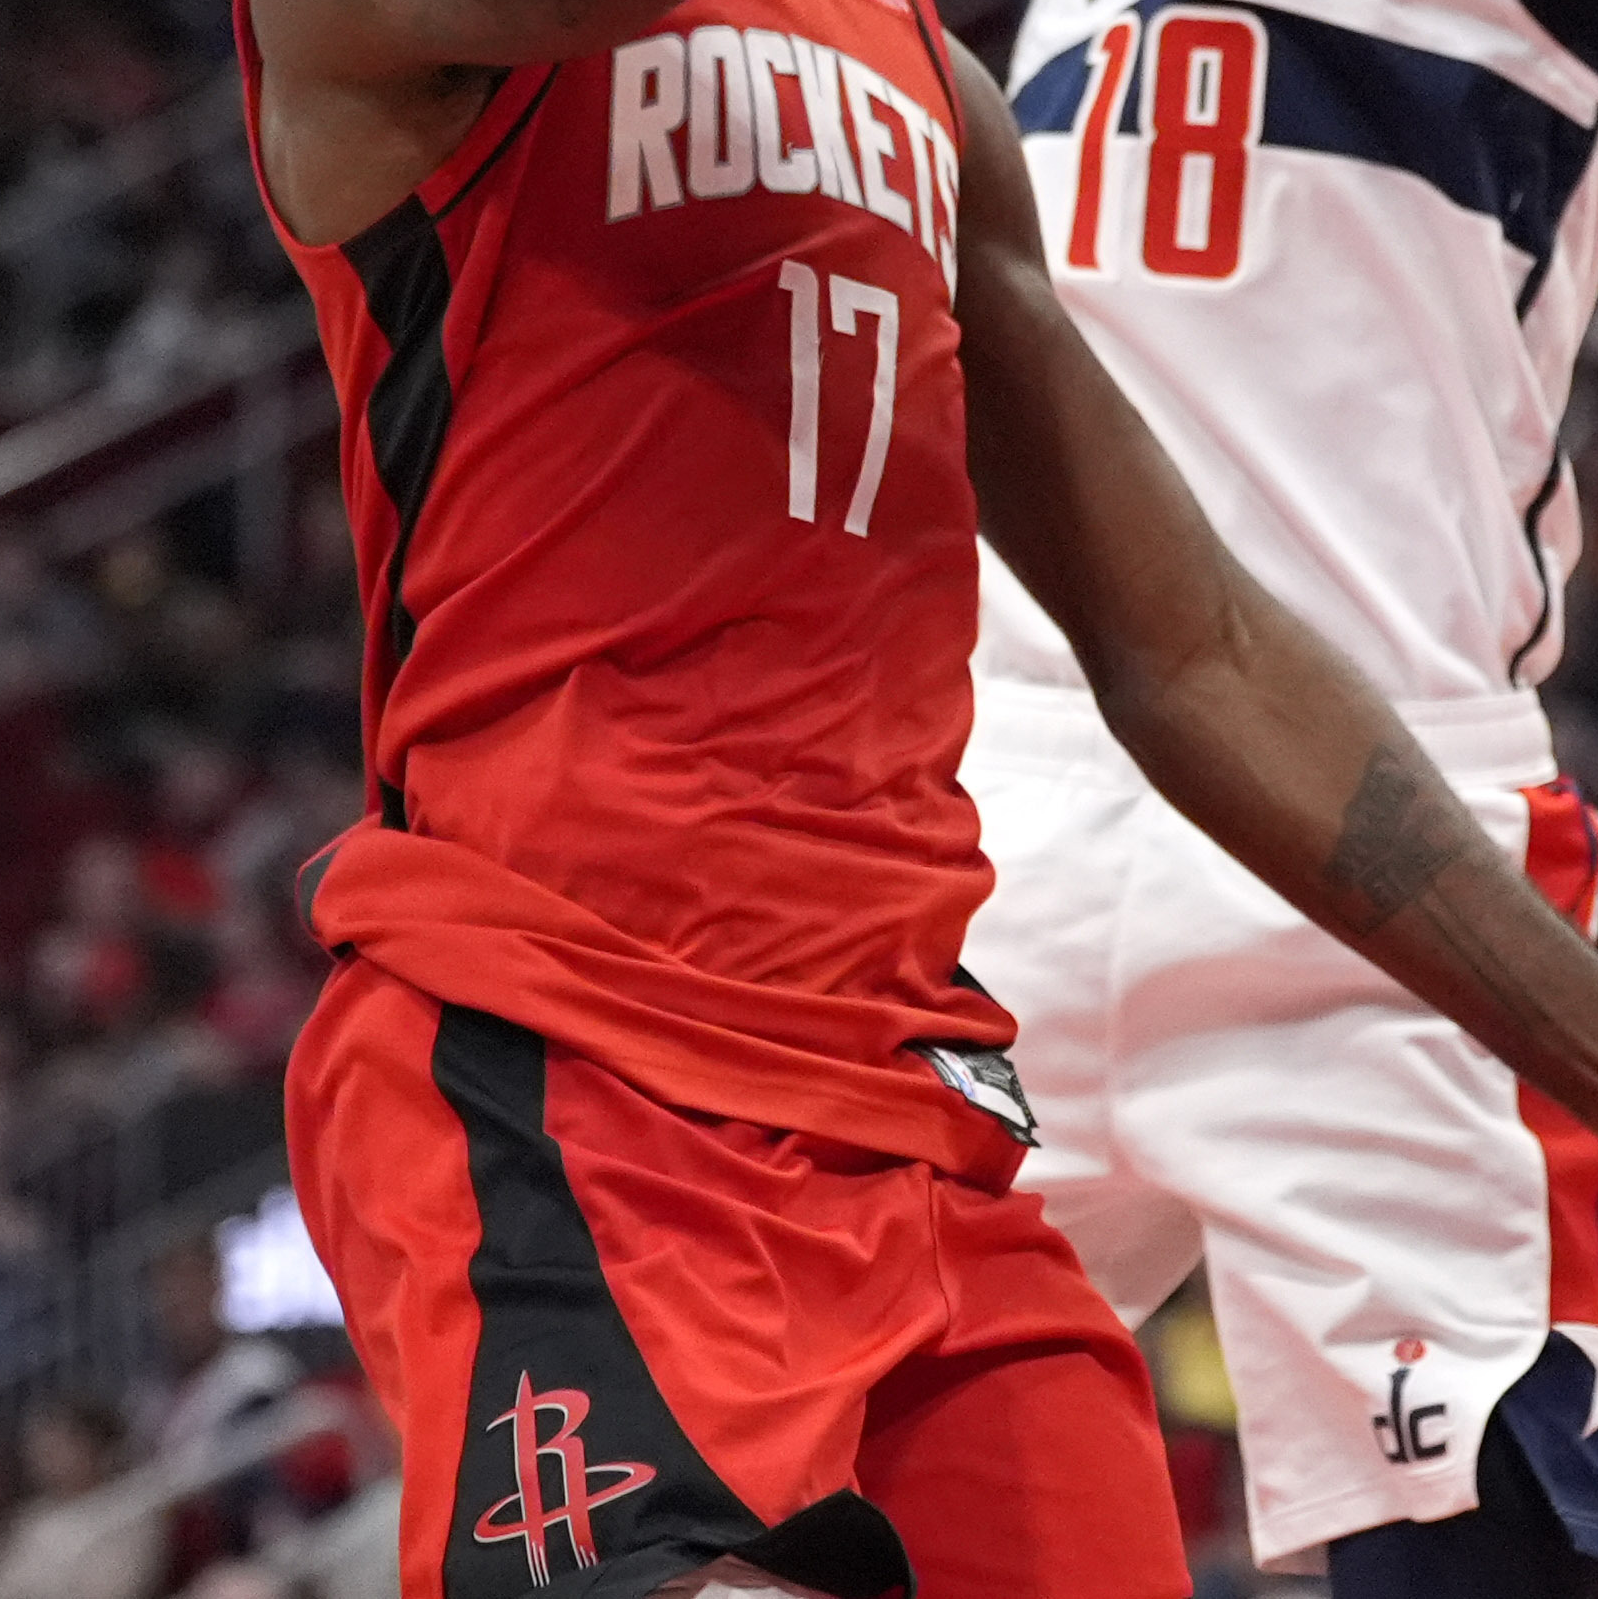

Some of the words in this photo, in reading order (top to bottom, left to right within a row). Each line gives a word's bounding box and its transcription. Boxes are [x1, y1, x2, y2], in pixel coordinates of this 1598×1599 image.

[605, 24, 959, 314] ROCKETS
[1067, 14, 1259, 282] 18
[778, 259, 900, 538] 17
